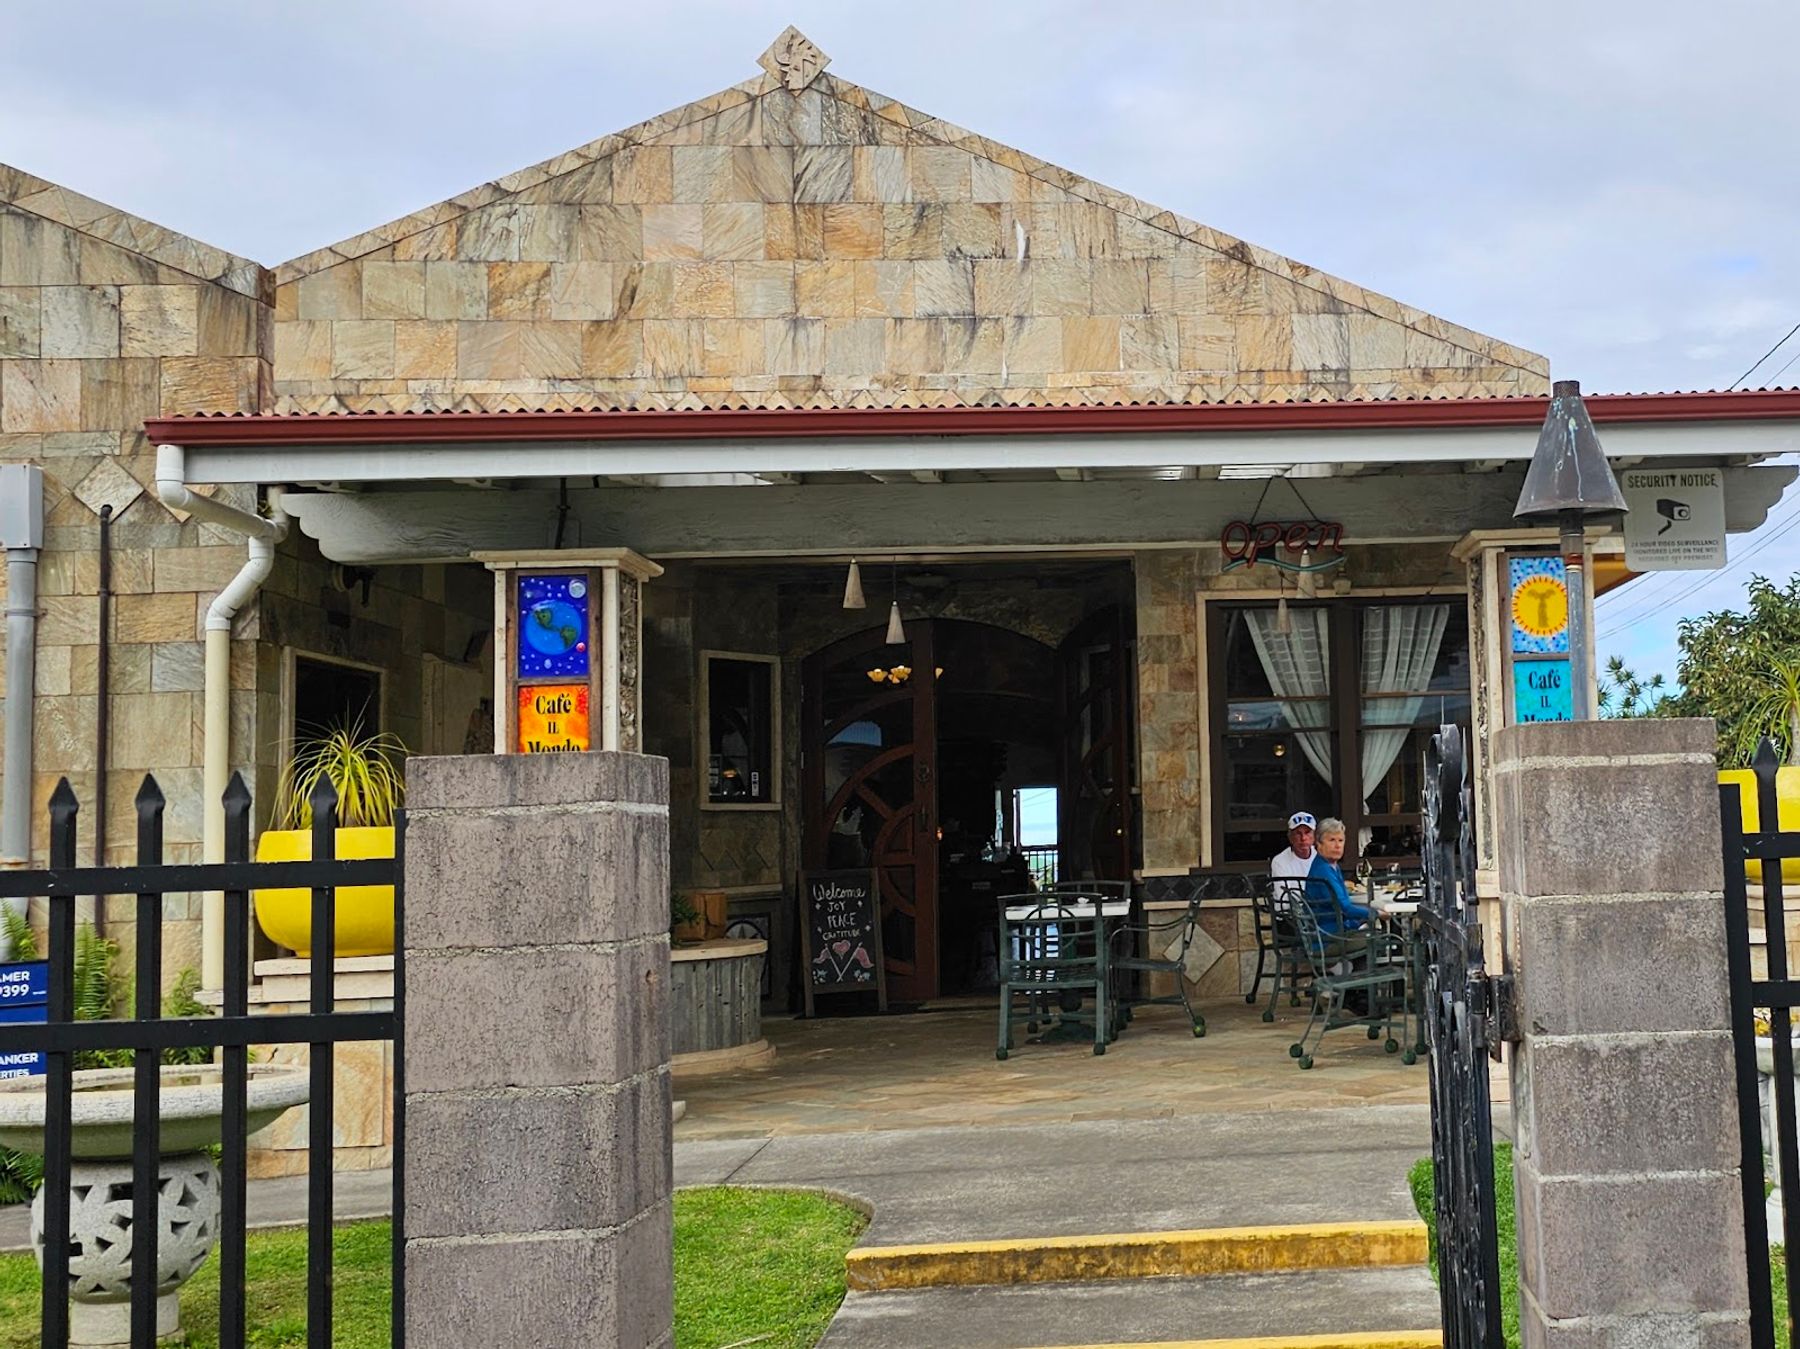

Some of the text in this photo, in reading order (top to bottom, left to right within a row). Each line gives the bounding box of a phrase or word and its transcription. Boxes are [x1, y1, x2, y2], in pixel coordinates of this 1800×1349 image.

[1628, 473, 1716, 488] SECURITY NOTICE
[1221, 521, 1343, 568] Open
[1529, 669, 1561, 689] Café
[535, 693, 571, 714] Café
[813, 882, 866, 901] Welcome
[827, 901, 845, 912] JOY
[827, 912, 856, 928] PEACE
[0, 971, 30, 982] MER
